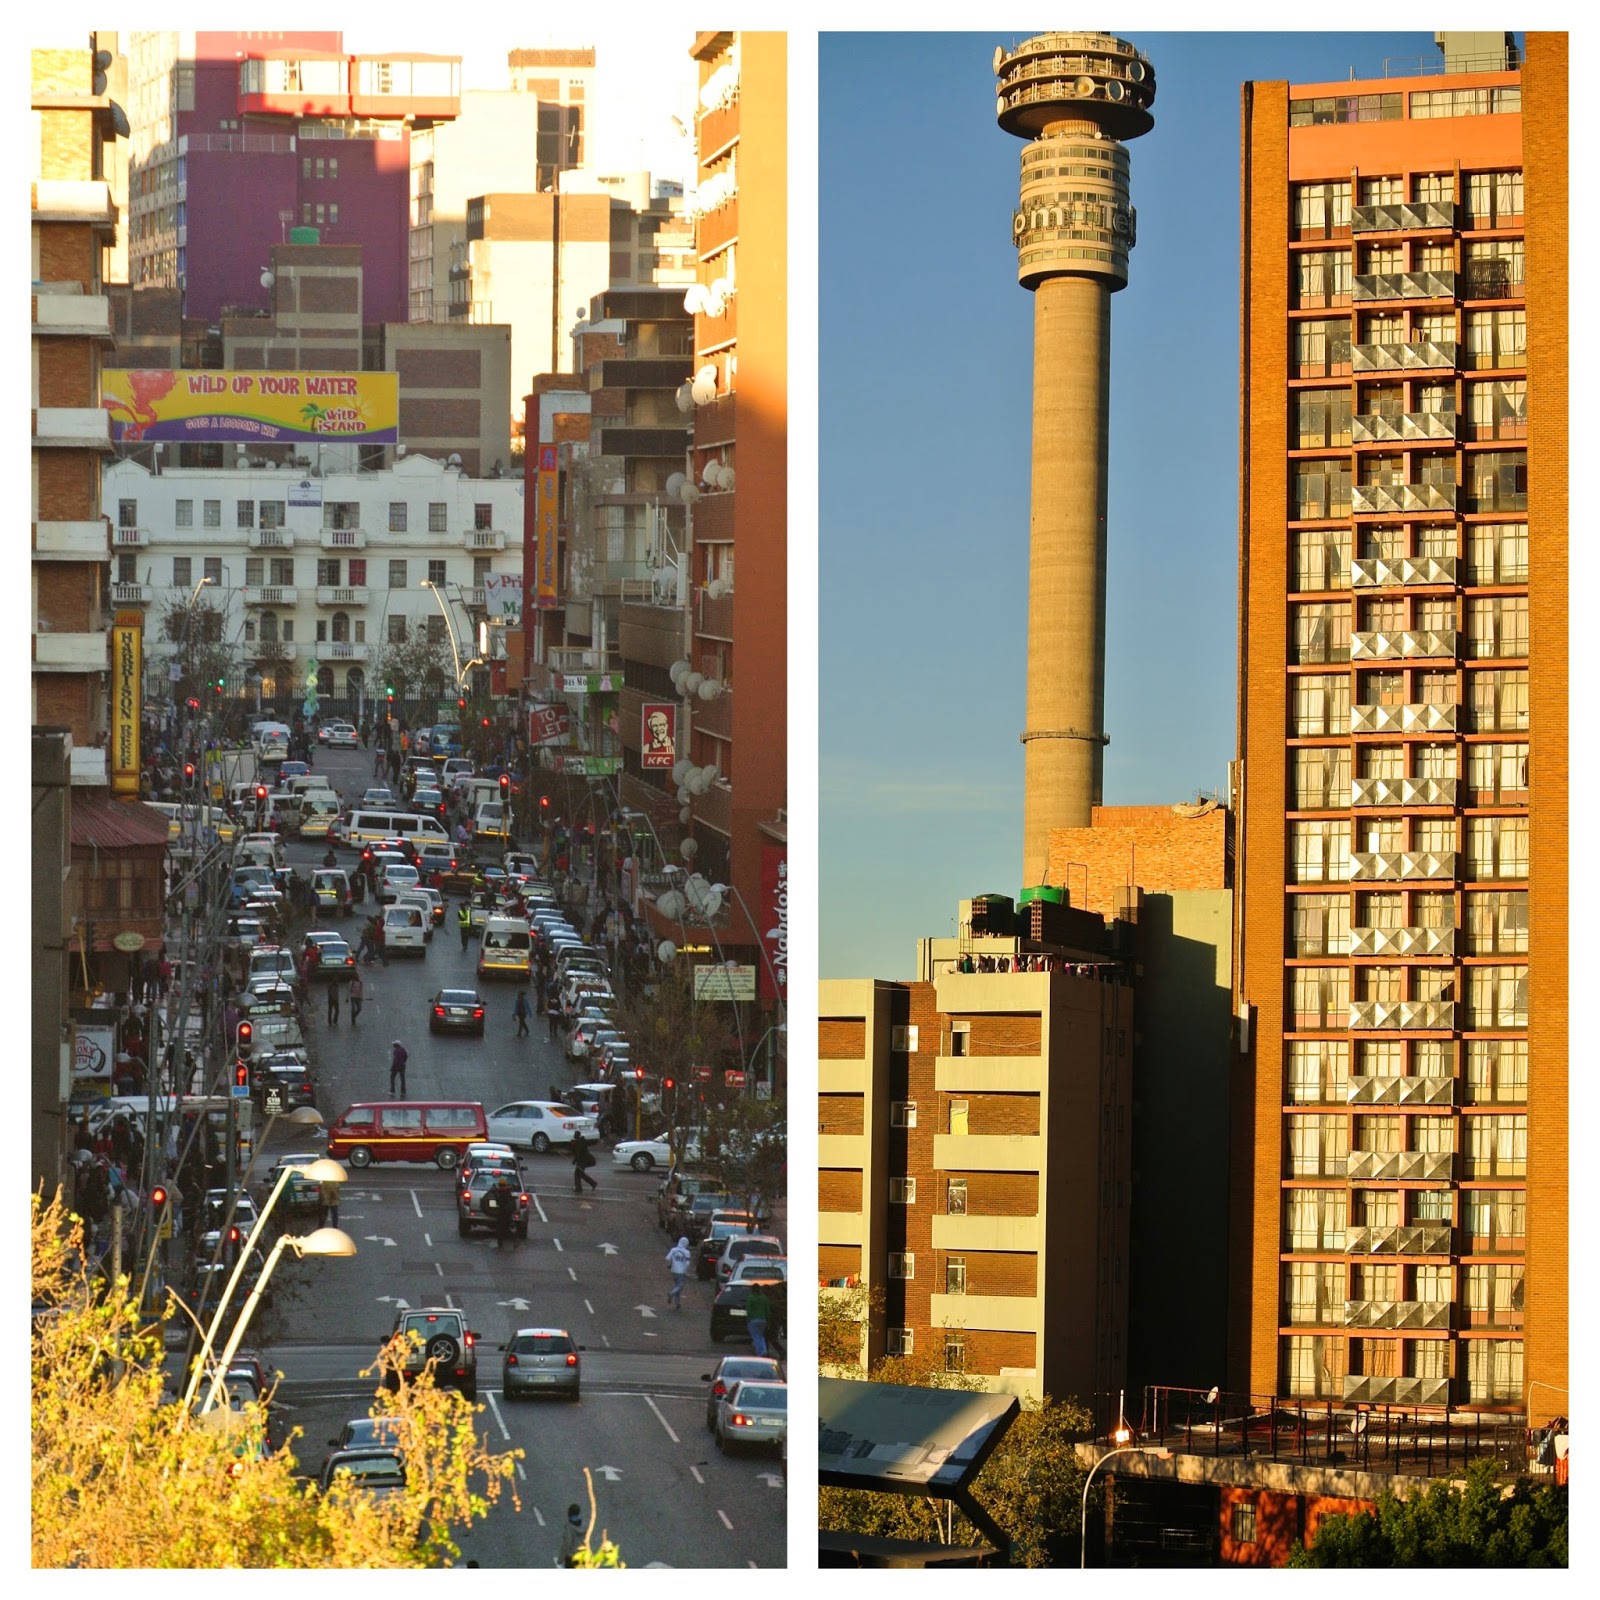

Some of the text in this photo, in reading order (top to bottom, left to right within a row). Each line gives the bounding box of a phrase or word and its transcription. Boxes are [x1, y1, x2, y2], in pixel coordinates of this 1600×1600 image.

[231, 376, 254, 394] UP
[258, 376, 300, 395] YOUR
[304, 377, 358, 396] WATER
[185, 417, 209, 429] GOES
[211, 417, 219, 428] A
[261, 425, 280, 439] WAY
[121, 632, 134, 719] HARRISON
[537, 709, 556, 723] TO
[539, 721, 562, 738] LET
[647, 756, 671, 765] KFC
[773, 880, 787, 966] Nando's
